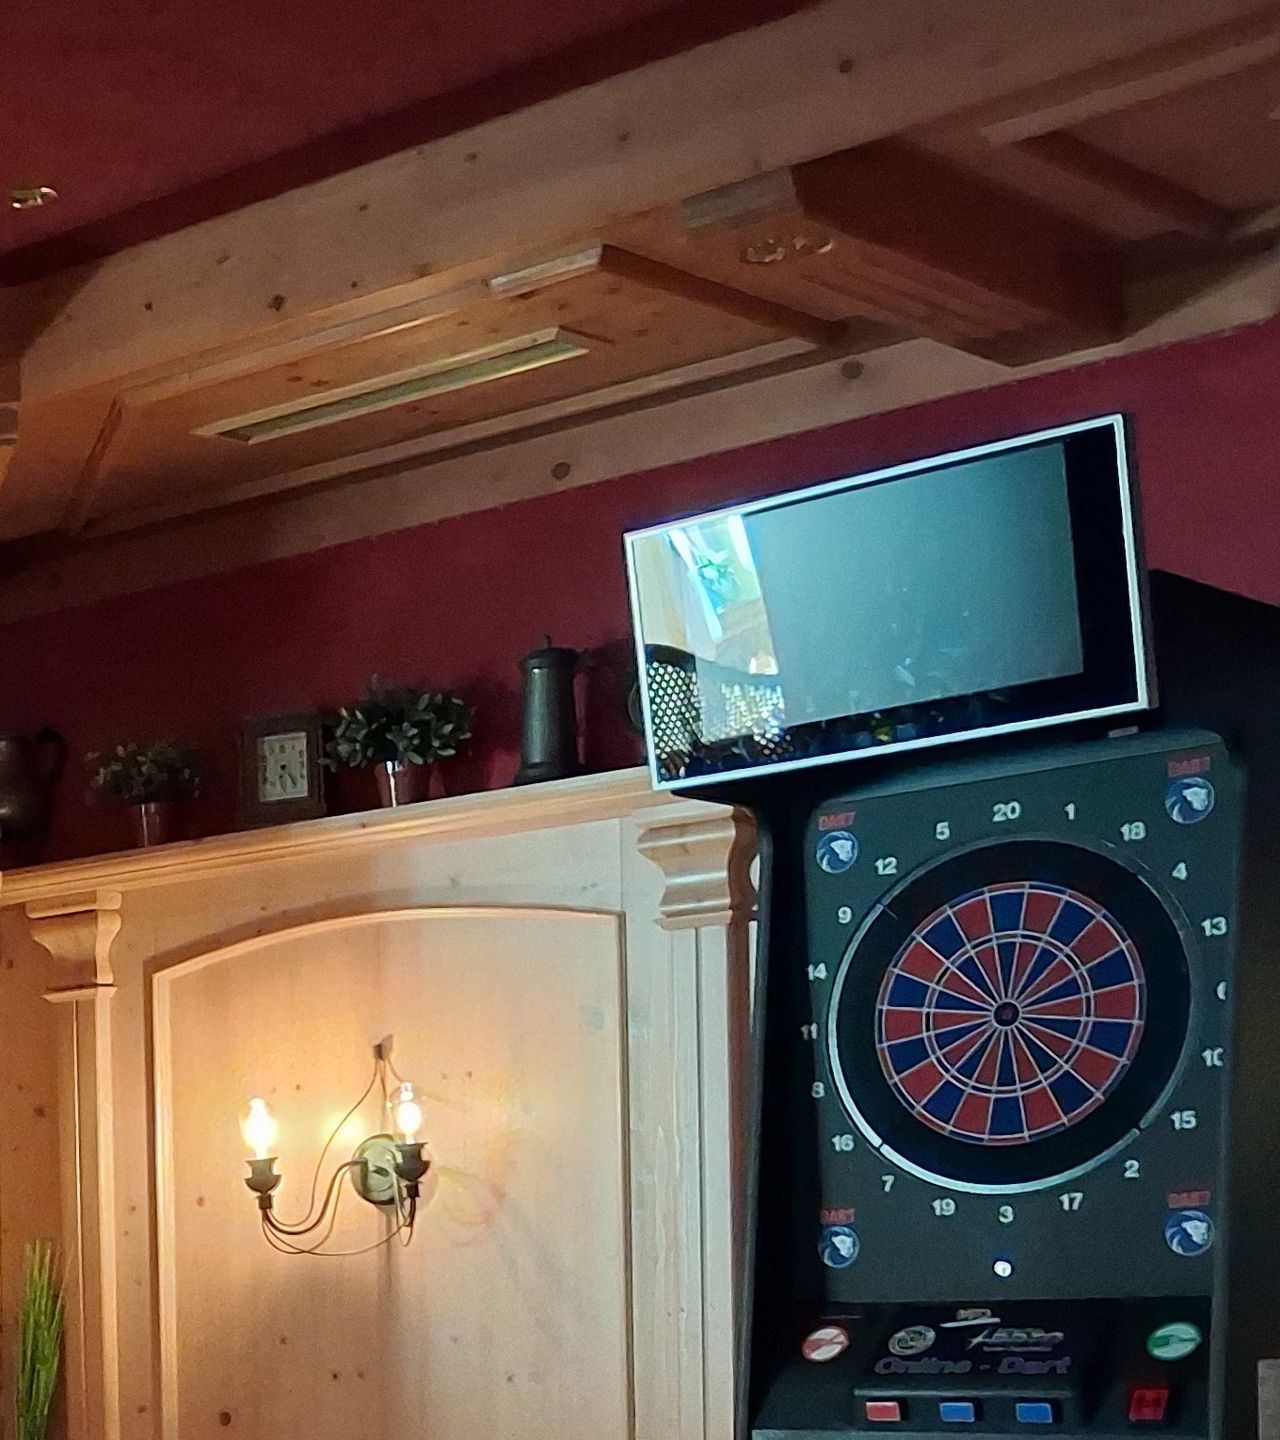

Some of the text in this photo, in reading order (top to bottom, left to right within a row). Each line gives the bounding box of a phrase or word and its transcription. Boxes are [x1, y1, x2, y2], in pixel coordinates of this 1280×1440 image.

[992, 801, 1021, 822] 20
[1064, 802, 1076, 821] 1
[935, 821, 950, 840] 5
[1120, 821, 1147, 842] 18
[874, 857, 897, 875] 12
[1172, 861, 1188, 880] 4
[837, 906, 852, 924] 9
[1200, 916, 1228, 937] 13
[807, 962, 828, 981] 14
[800, 1022, 818, 1041] 11
[811, 1081, 825, 1098] 8
[1170, 1110, 1197, 1130] 15
[831, 1134, 855, 1152] 16
[1123, 1159, 1140, 1178] 2
[881, 1174, 895, 1193] 7
[931, 1198, 956, 1217] 19
[1059, 1192, 1084, 1211] 17
[998, 1205, 1014, 1223] 3
